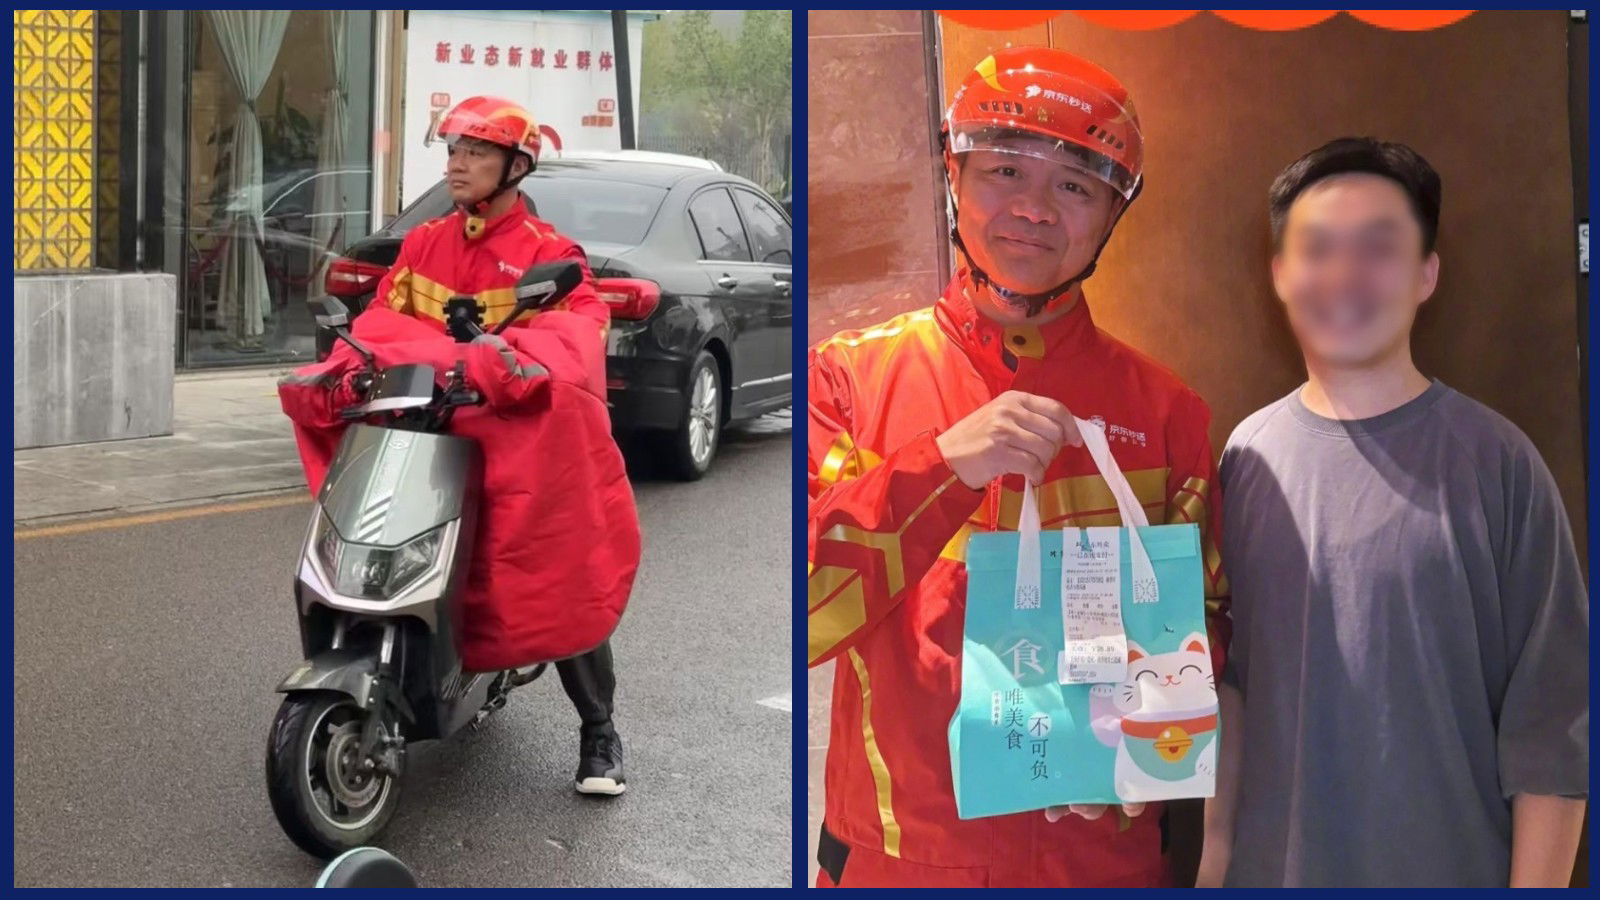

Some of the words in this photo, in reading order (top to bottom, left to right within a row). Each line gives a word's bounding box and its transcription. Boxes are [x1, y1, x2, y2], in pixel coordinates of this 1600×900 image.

[435, 41, 613, 72] 新业态新就业群体
[1043, 90, 1092, 113] 京东秒送
[1000, 638, 1045, 679] 食
[1004, 688, 1024, 750] 唯美食
[1029, 716, 1049, 781] 不可负
